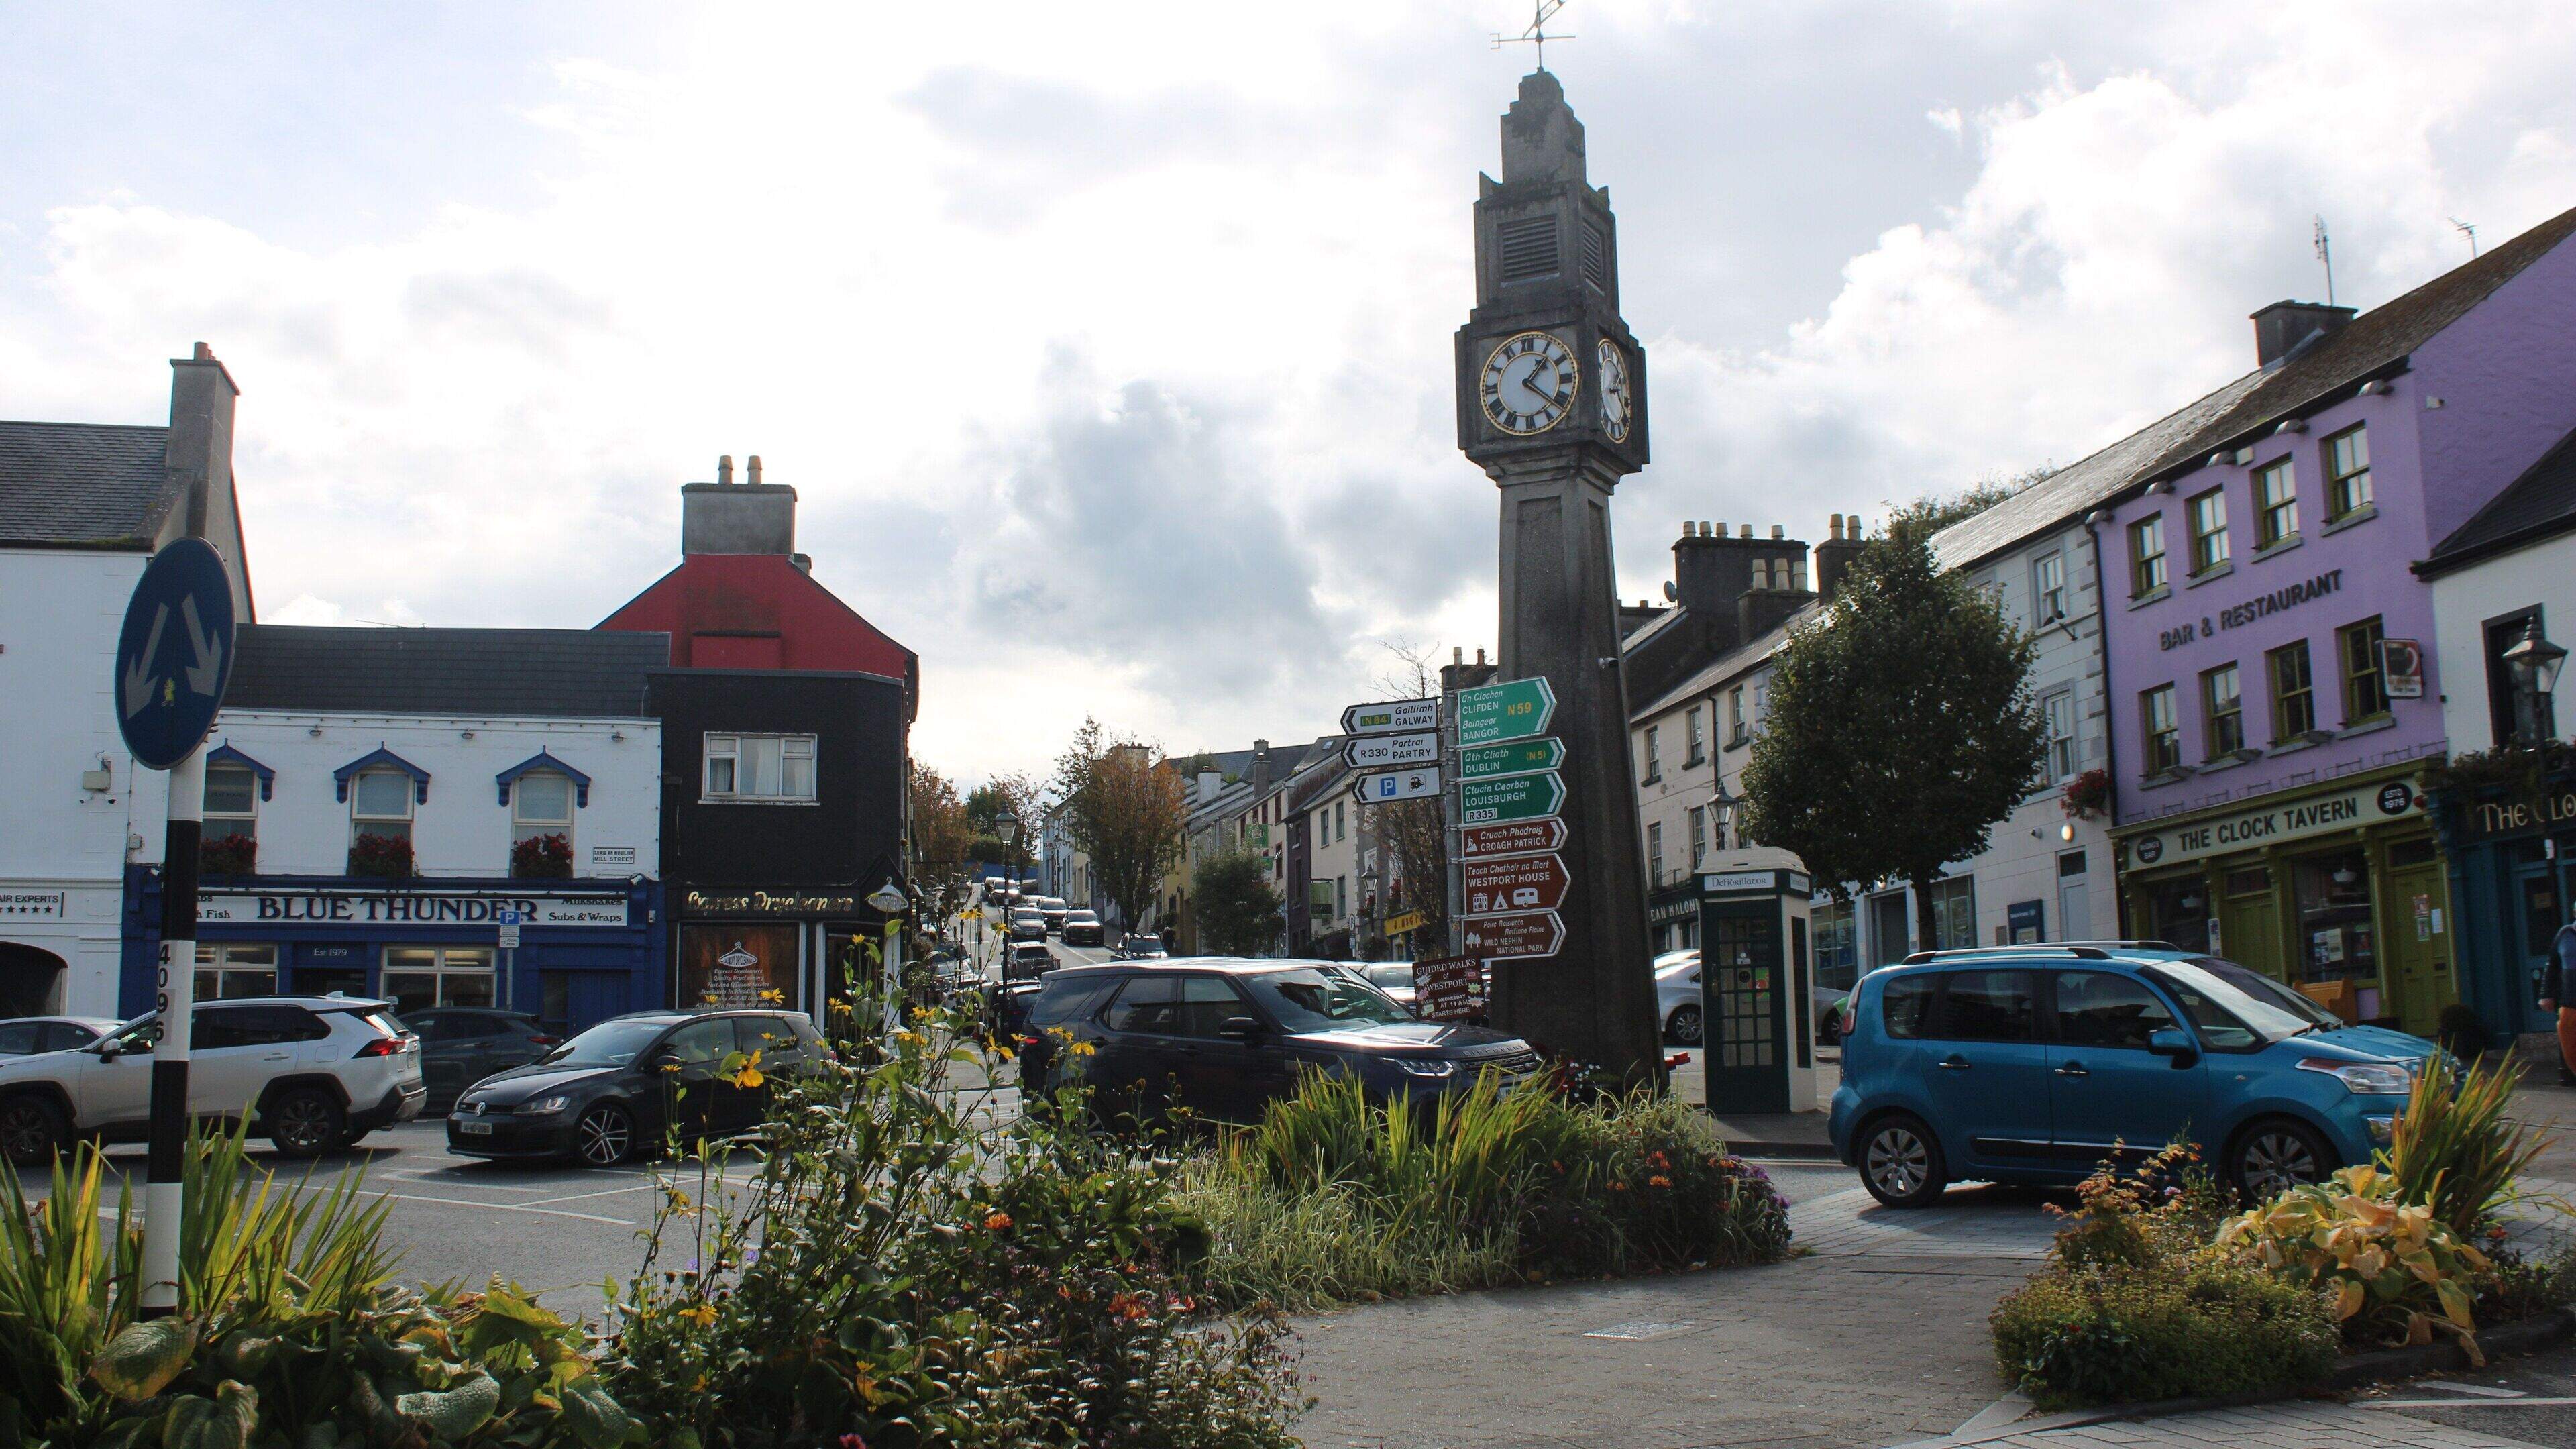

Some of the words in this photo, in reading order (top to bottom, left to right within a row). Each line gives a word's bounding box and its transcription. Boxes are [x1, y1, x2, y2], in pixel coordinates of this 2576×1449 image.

[2159, 623, 2194, 651] BAR
[2201, 616, 2212, 637] &
[2220, 568, 2342, 631] RESTAURANT
[1395, 704, 1434, 715] Gaillimh
[1462, 701, 1499, 715] CLIFDEN
[1395, 715, 1434, 726] GALWAY
[1462, 717, 1497, 729] Baingear
[1463, 727, 1499, 741] BANGOR
[1393, 749, 1432, 759] PARTRY
[1483, 749, 1509, 760] Cliath
[1466, 761, 1500, 773] DUBLIN
[1465, 784, 1492, 795] Cluain
[1466, 791, 1527, 806] LOUISBURGH
[2384, 798, 2405, 809] 1976
[2178, 828, 2210, 851] THE
[2218, 813, 2277, 844] CLOCK
[2284, 797, 2357, 830] TAVERN
[1480, 828, 1507, 841] Cruach
[1481, 840, 1512, 852] CROAGH
[1514, 837, 1546, 848] PATRICK
[1468, 865, 1487, 876] Teach
[1490, 863, 1519, 874] Chathair
[1532, 860, 1550, 869] Mart
[1468, 875, 1516, 888] WESTPORT
[1519, 871, 1550, 884] HOUSE
[15, 894, 59, 903] EXPERTS
[206, 909, 231, 918] Fish
[258, 896, 354, 920] BLUE
[360, 896, 538, 921] THUNDER
[549, 912, 576, 921] Subs
[578, 912, 586, 921] &
[588, 912, 622, 923] Wraps
[1484, 938, 1499, 947] WILD
[1500, 936, 1523, 945] NEPHIN
[313, 947, 327, 956] Est
[329, 947, 347, 956] 1979
[1497, 945, 1526, 955] NATIONAL
[1528, 943, 1544, 952] PARK
[1416, 963, 1447, 975] GUIDED
[1449, 958, 1476, 970] WALKS
[1426, 978, 1468, 991] WESTPORT
[1438, 994, 1466, 1002] WEDNESDAY
[1432, 1009, 1454, 1018] STARTS
[1454, 1006, 1470, 1015] HERE
